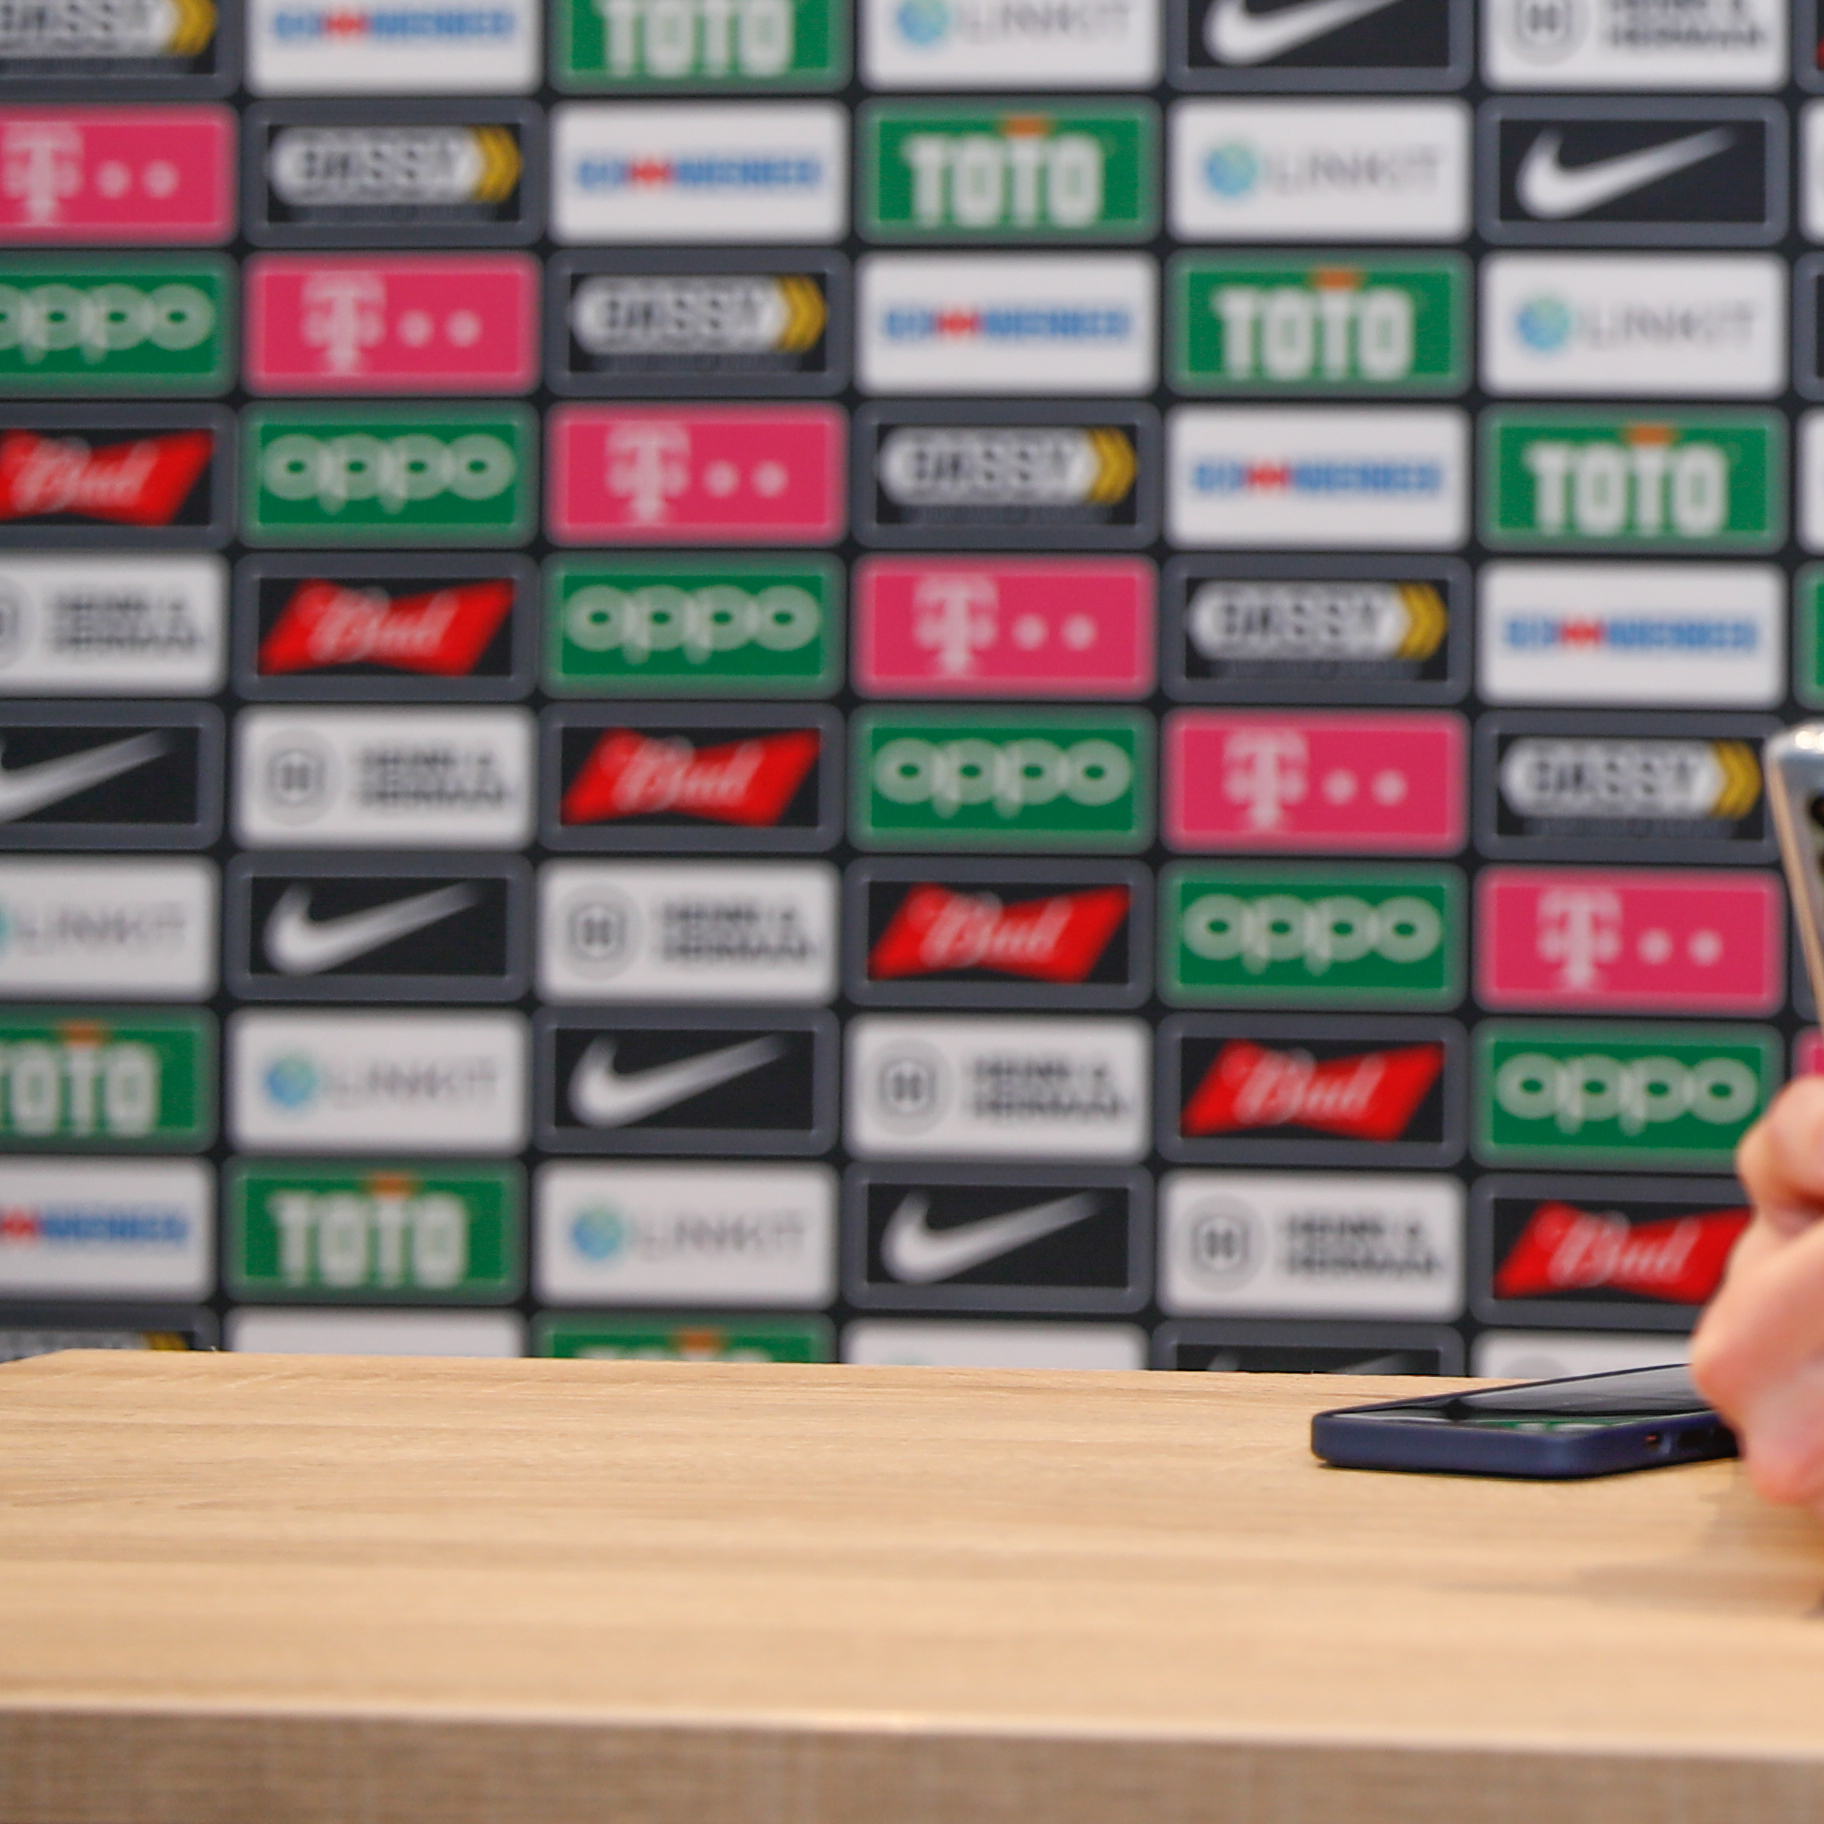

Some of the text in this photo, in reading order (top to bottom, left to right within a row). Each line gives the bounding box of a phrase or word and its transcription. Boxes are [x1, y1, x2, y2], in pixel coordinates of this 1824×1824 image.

[901, 134, 1102, 225] TOTO
[1211, 286, 1413, 379] TOTO
[259, 436, 516, 513] oppo
[1523, 441, 1727, 535] TOTO
[563, 587, 821, 665] oppo
[873, 739, 1132, 819] oppo
[1182, 895, 1442, 977] oppo
[0, 1041, 159, 1132] OTO
[1493, 1054, 1755, 1138] oppo
[266, 1191, 467, 1284] TOTO
